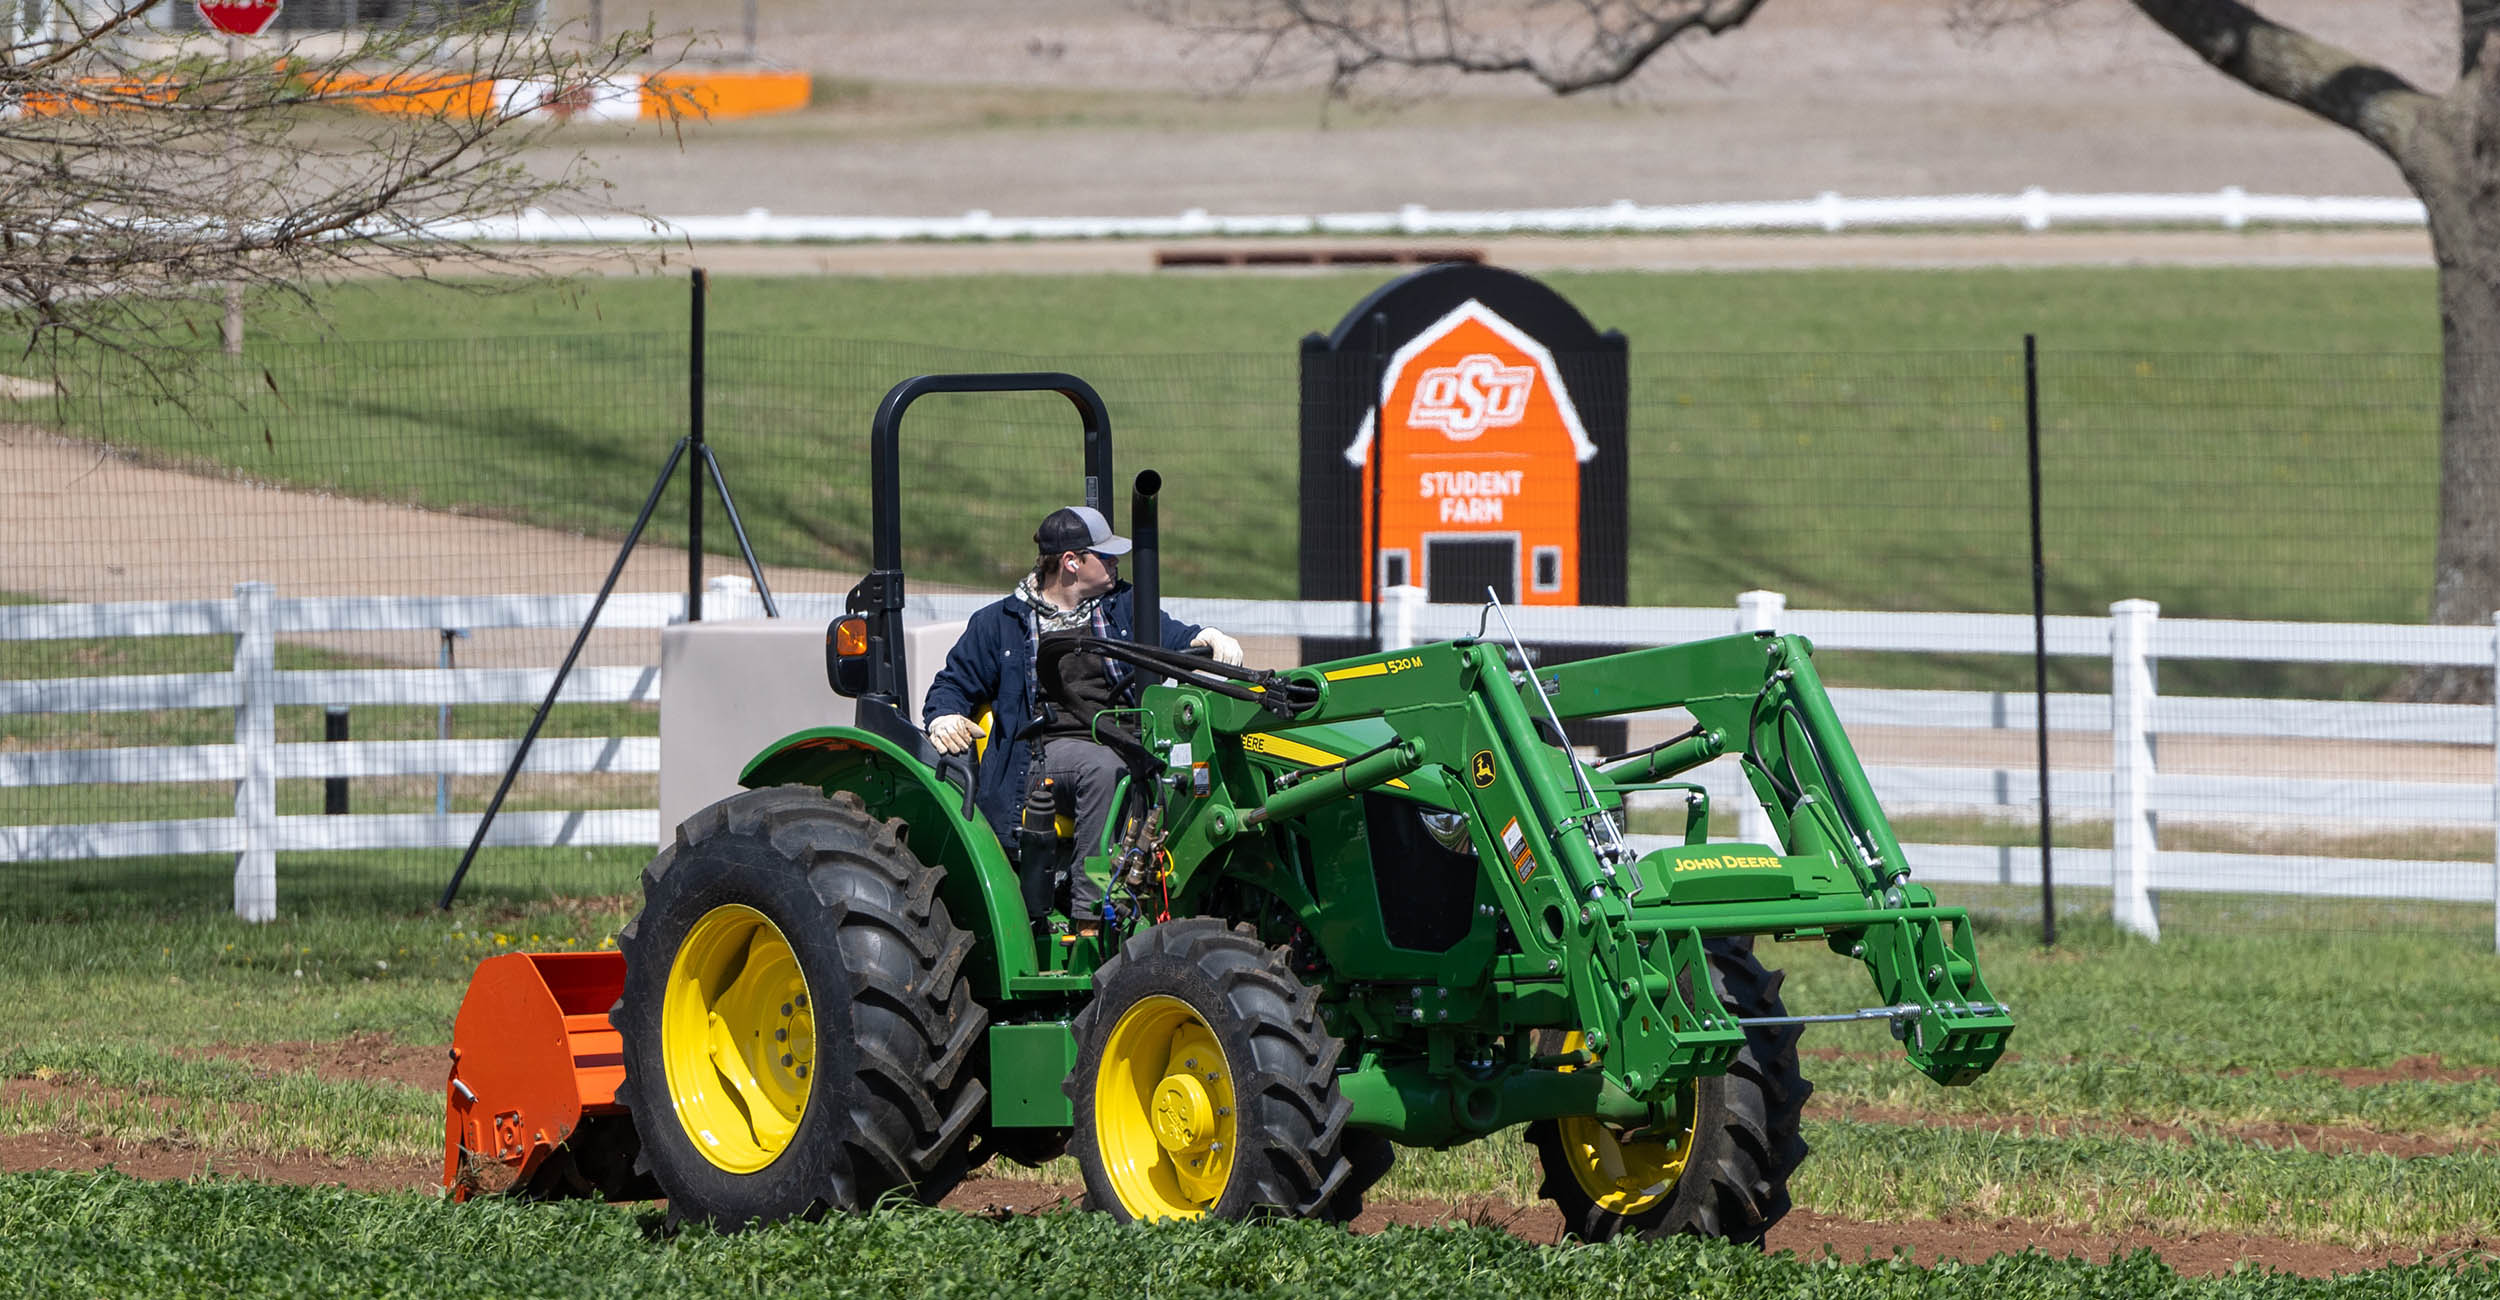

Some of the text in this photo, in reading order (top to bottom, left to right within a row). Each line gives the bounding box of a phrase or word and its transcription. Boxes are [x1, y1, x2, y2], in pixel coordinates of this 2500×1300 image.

[1408, 354, 1535, 440] OSU
[1420, 470, 1523, 498] STUDENT
[1440, 497, 1503, 523] FARM
[1387, 655, 1424, 674] 520 M
[1241, 734, 1265, 751] EERE
[1674, 855, 1782, 872] JOHN DEERE
